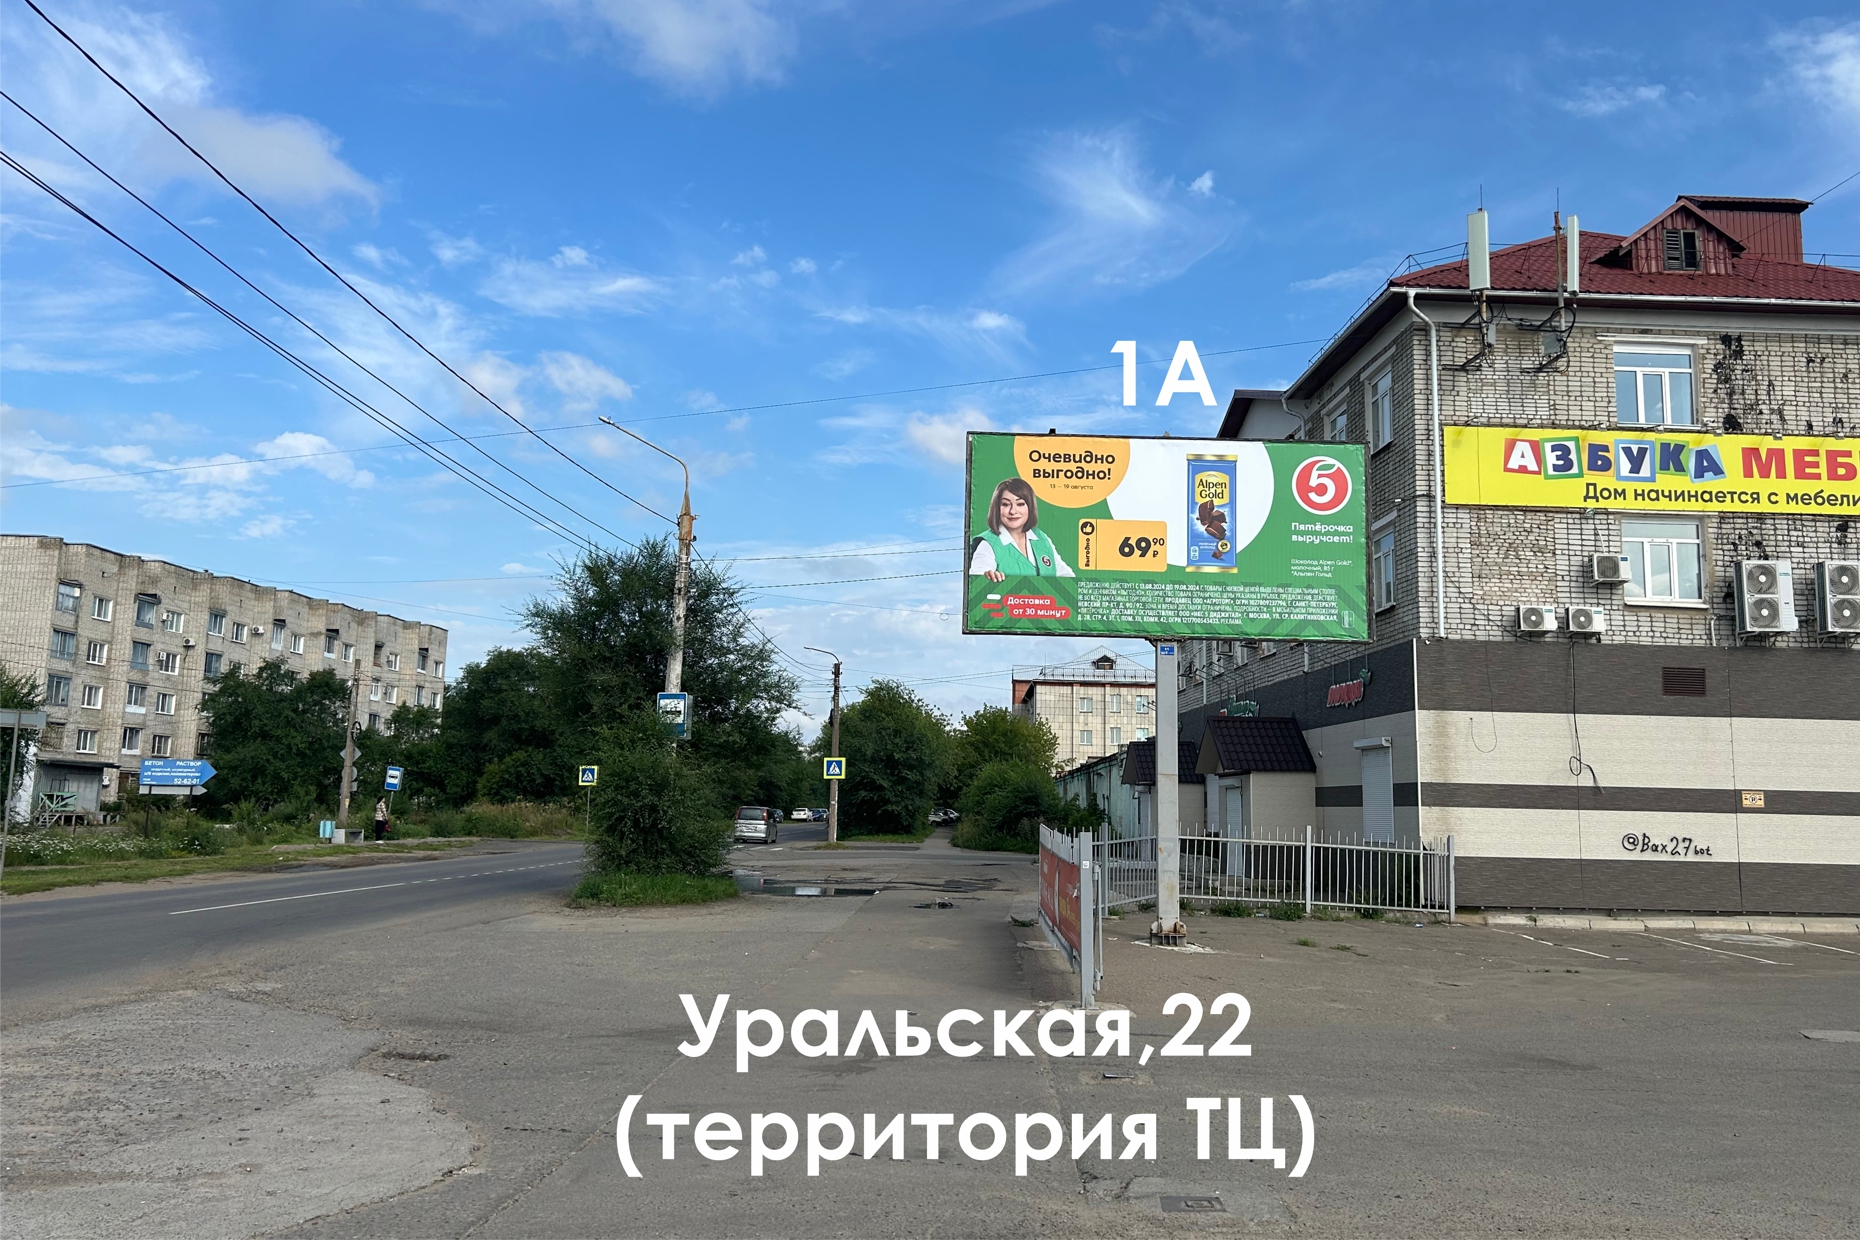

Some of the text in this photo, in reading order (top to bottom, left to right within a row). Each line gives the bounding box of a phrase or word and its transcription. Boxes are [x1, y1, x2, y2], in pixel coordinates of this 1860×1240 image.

[1029, 450, 1116, 464] Очевидно
[1505, 438, 1860, 481] АЗБУКА МЕБ
[1032, 466, 1112, 480] выгодно!
[1198, 478, 1226, 492] Alpen
[1200, 489, 1224, 499] Gold
[1583, 482, 1627, 502] Дом
[1633, 487, 1760, 504] начинается
[1767, 492, 1779, 504] с
[1292, 522, 1354, 533] Пятёрочка
[1118, 536, 1152, 557] 69
[1152, 538, 1164, 546] 90
[1292, 535, 1353, 544] выручает!
[1007, 597, 1050, 605] Доставка
[1037, 610, 1066, 618] минут
